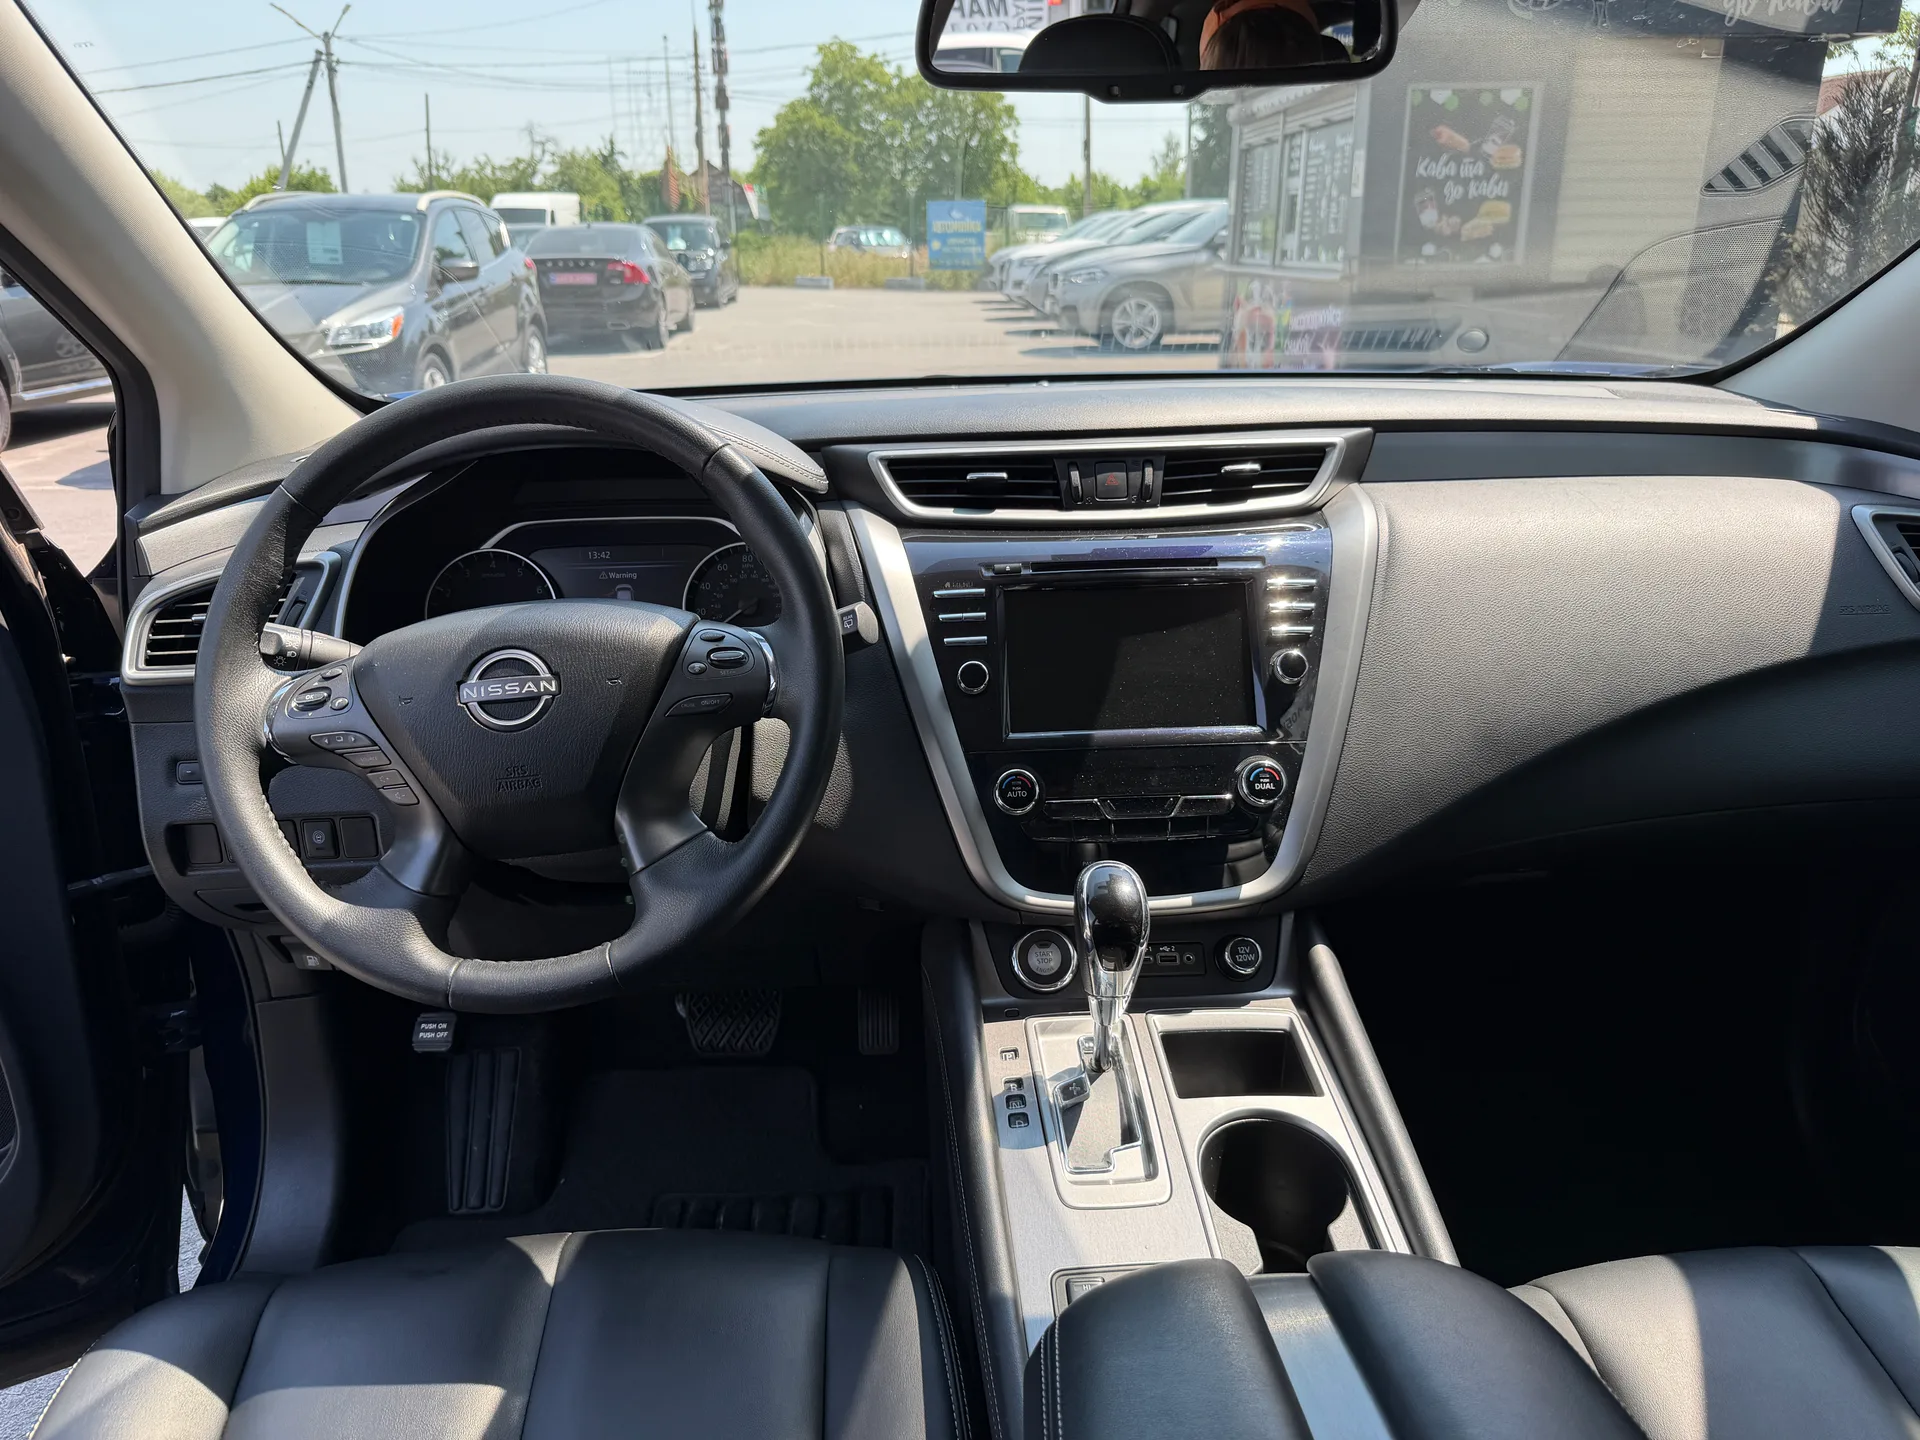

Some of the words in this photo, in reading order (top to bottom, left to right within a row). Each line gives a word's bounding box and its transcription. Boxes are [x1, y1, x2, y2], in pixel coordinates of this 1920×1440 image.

[1416, 153, 1457, 180] Кава
[1444, 180, 1465, 205] до
[1468, 174, 1509, 199] кави
[588, 551, 611, 559] 13:42
[742, 554, 753, 562] 80
[717, 563, 728, 571] 60
[609, 571, 637, 580] Warning
[700, 582, 711, 590] 40
[463, 680, 556, 699] NISSAN
[506, 764, 529, 777] SRS
[497, 778, 543, 792] AIRBAG
[1255, 782, 1276, 790] DUAL
